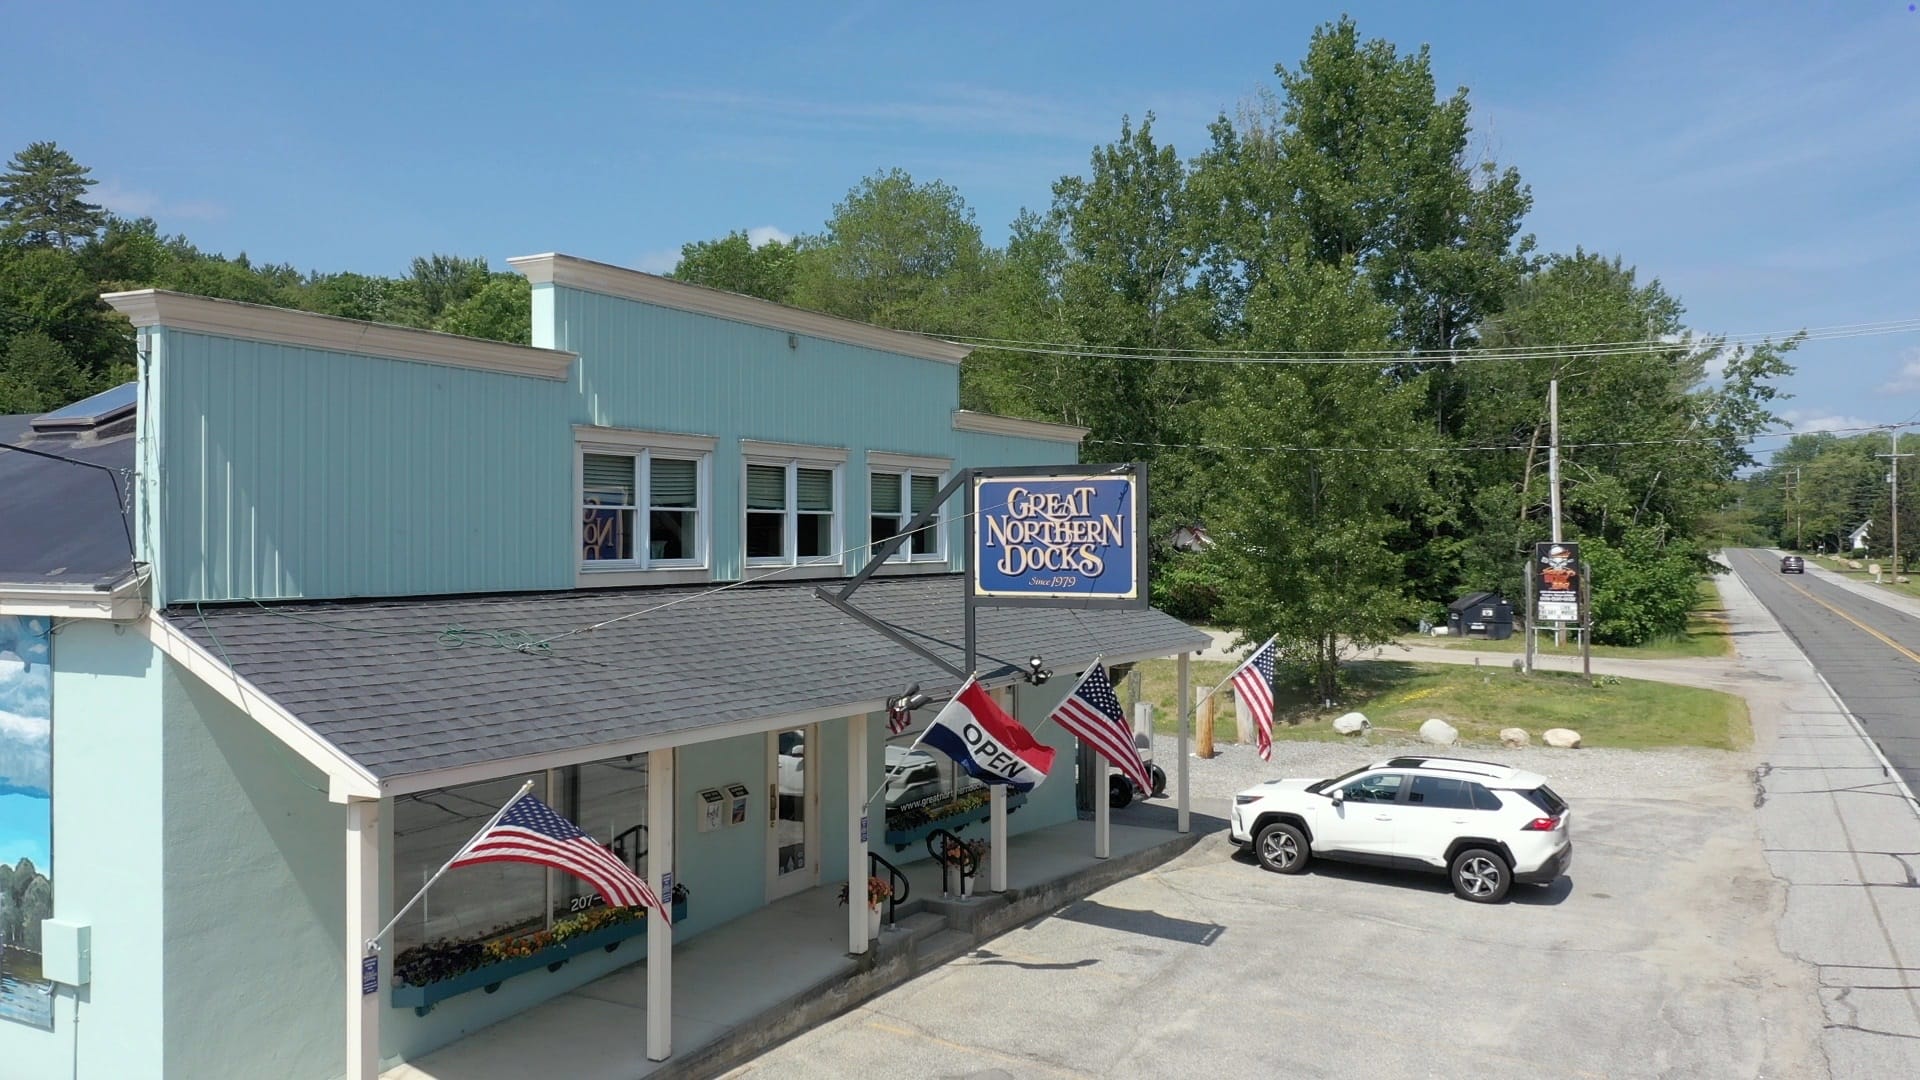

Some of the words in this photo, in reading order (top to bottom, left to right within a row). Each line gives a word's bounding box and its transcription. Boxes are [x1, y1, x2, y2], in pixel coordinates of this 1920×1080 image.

[1007, 487, 1097, 522] GREAT
[986, 514, 1124, 549] NORTHERN
[997, 544, 1104, 577] DOCKS
[1028, 577, 1050, 586] Since
[1050, 576, 1076, 588] 1979
[963, 723, 1027, 778] OPEN
[570, 893, 602, 912] 207-
